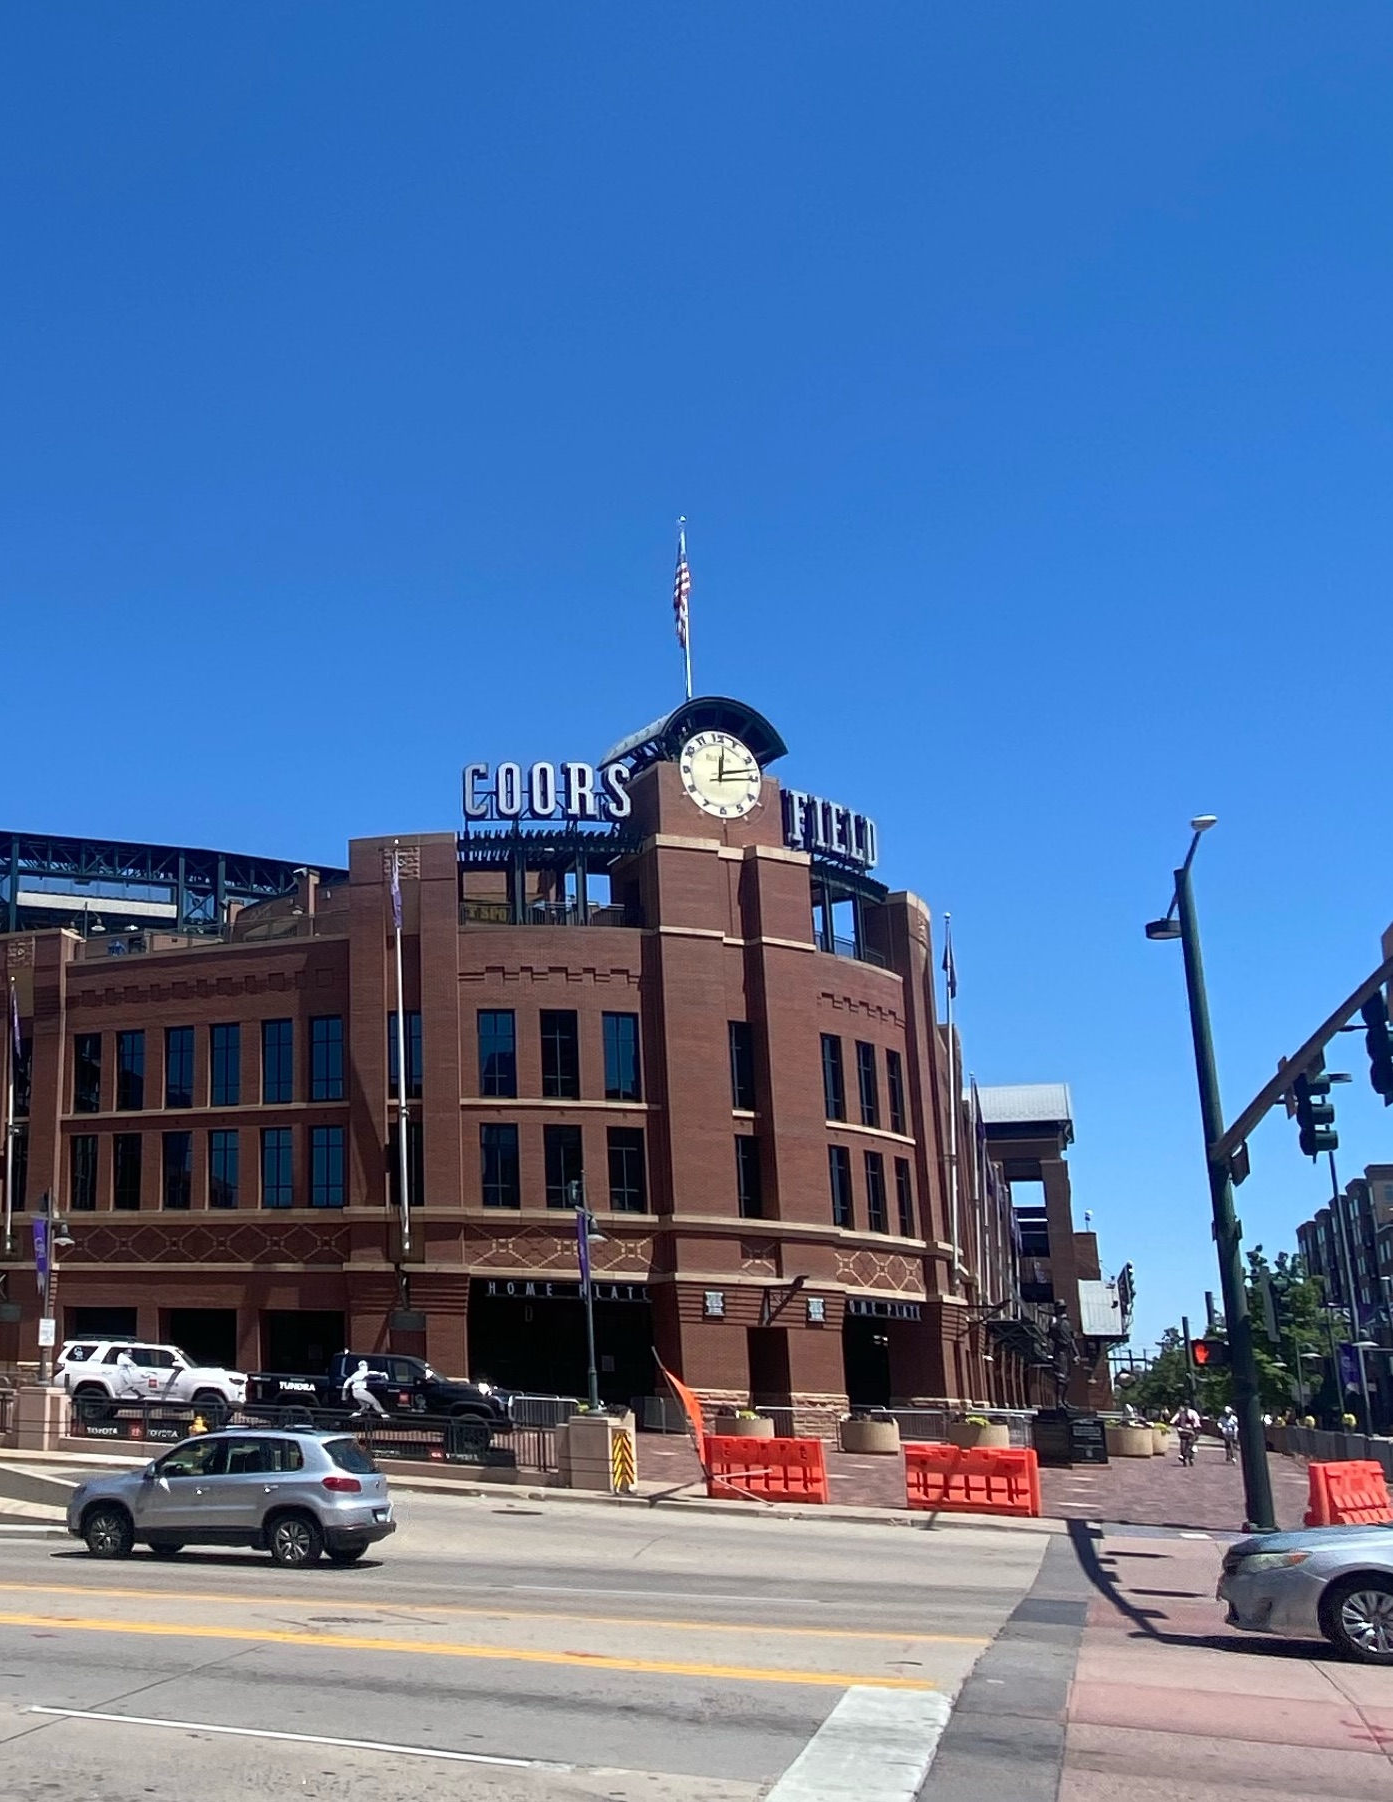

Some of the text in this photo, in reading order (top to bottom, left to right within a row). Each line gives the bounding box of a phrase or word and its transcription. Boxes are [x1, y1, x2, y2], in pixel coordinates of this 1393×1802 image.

[463, 762, 632, 818] COORS
[785, 789, 878, 868] FIELD
[488, 1281, 553, 1297] HOME
[279, 1380, 316, 1391] TUNDRA
[87, 1426, 118, 1435] TOYOTA
[148, 1429, 178, 1438] TOYOTA
